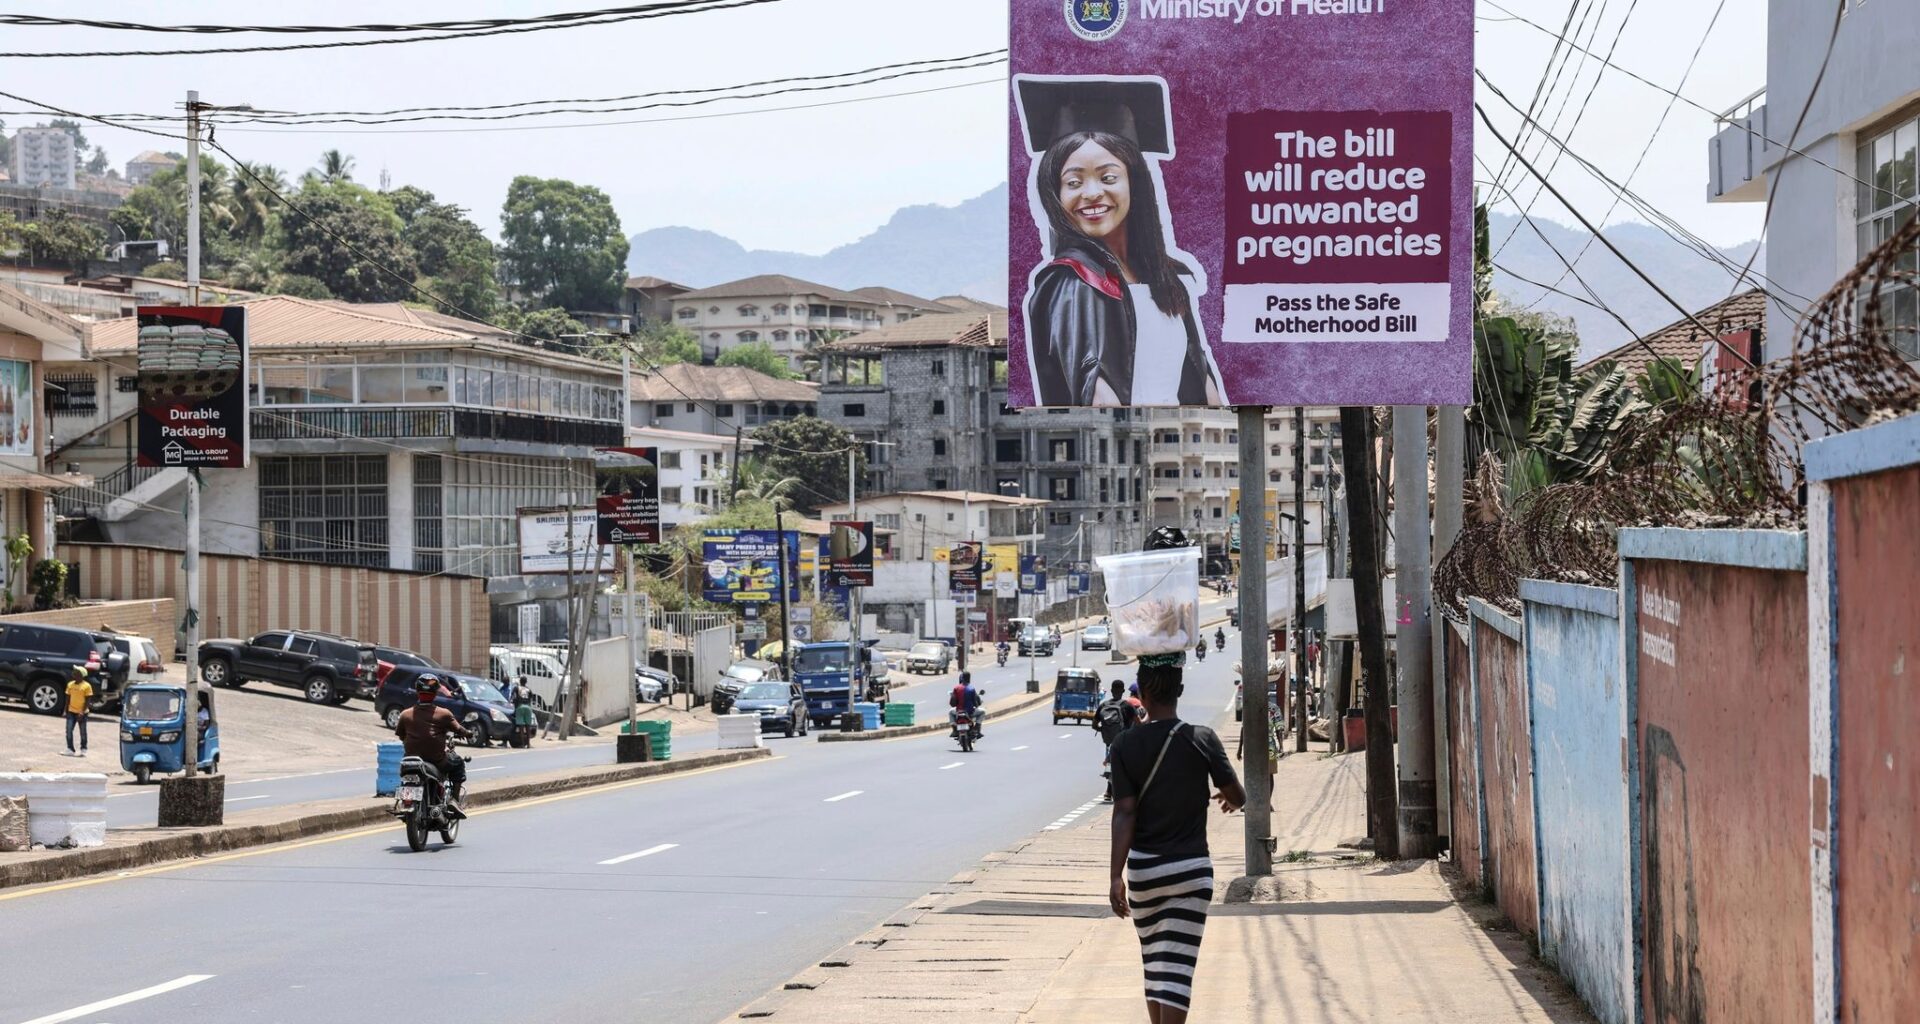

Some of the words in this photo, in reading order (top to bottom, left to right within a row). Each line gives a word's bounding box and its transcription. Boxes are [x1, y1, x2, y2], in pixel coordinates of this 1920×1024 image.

[1140, 0, 1249, 23] Ministry
[1256, 0, 1285, 16] of
[1274, 129, 1337, 158] The
[1344, 127, 1395, 157] bill
[1244, 162, 1302, 192] will
[1310, 162, 1426, 191] reduce
[1251, 194, 1418, 225] unwanted
[1236, 226, 1442, 265] pregnancies
[1266, 295, 1312, 311] Pass
[1316, 294, 1350, 311] the
[1355, 292, 1401, 311] Safe
[1255, 316, 1380, 333] Motherhood
[1385, 315, 1417, 333] Bill
[170, 408, 220, 420] Durable
[161, 425, 226, 438] Packaging
